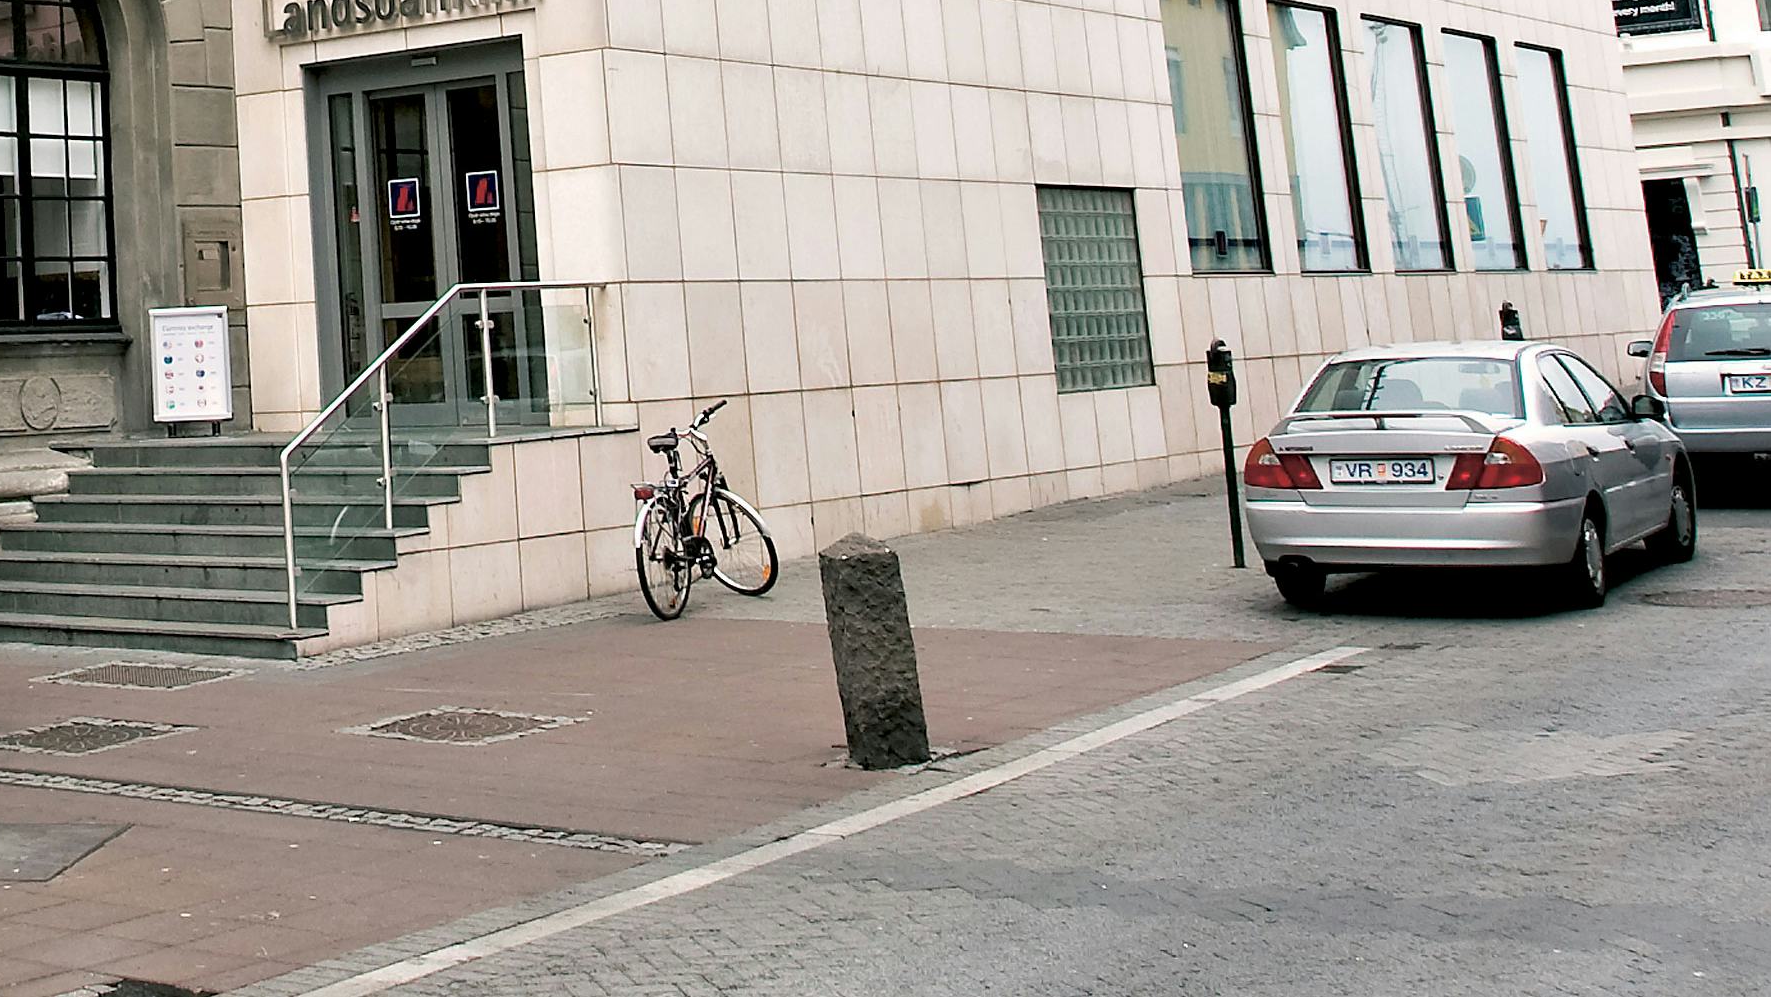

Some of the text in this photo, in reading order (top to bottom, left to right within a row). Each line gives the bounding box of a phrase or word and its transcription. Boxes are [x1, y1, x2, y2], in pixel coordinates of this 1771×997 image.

[1742, 377, 1767, 389] KZ
[1345, 462, 1429, 478] VR 934
